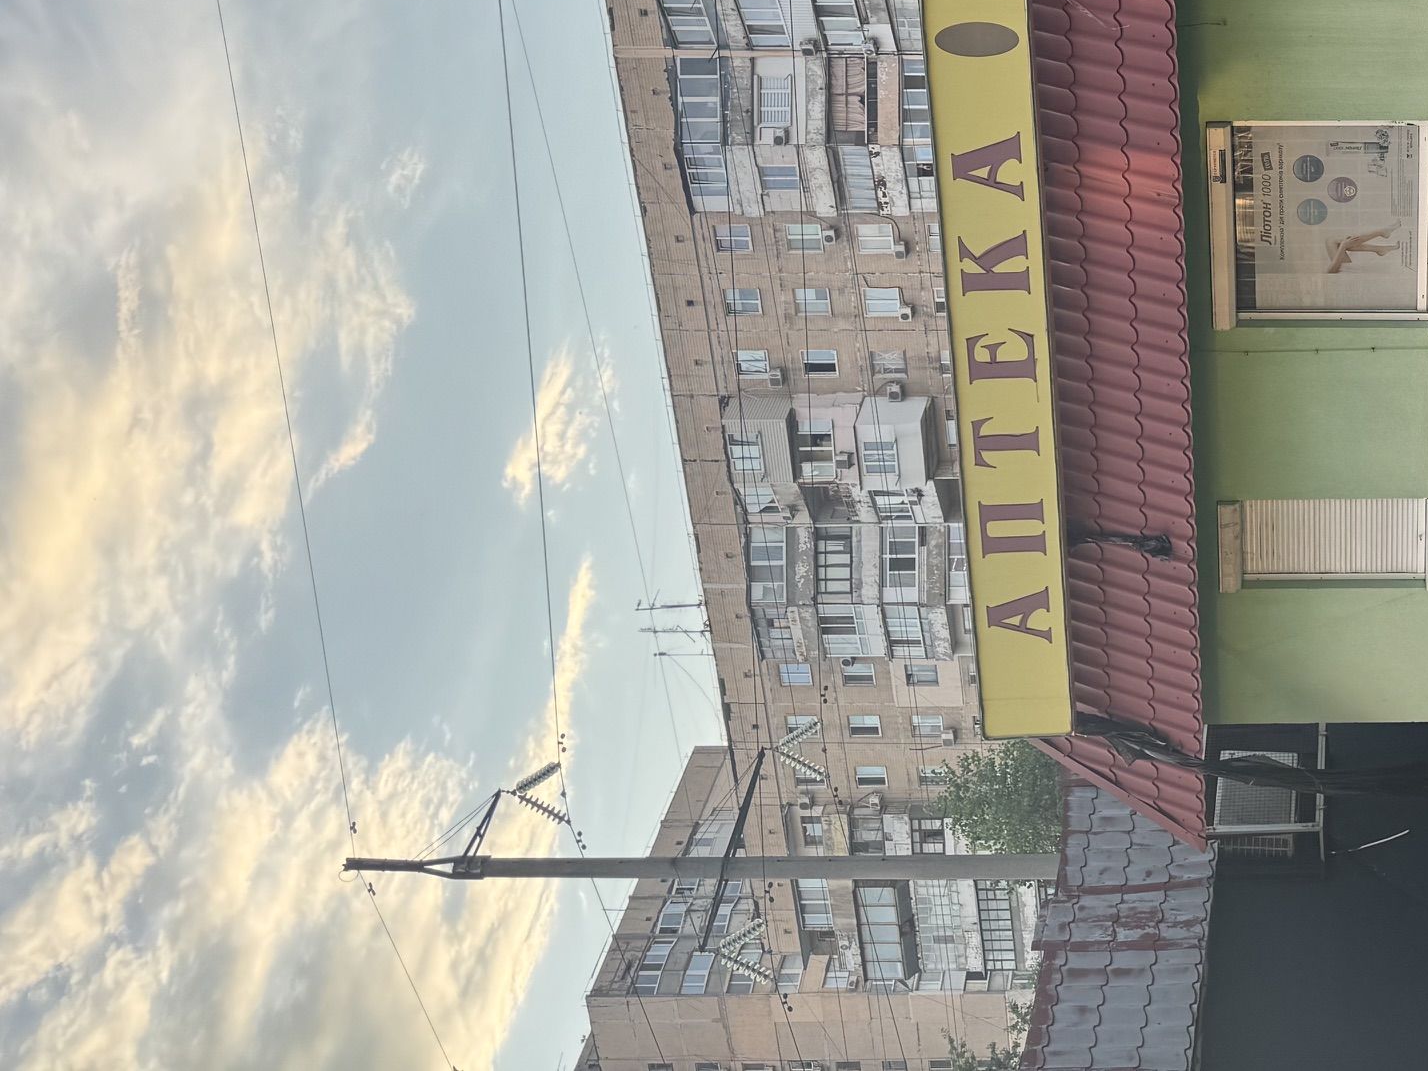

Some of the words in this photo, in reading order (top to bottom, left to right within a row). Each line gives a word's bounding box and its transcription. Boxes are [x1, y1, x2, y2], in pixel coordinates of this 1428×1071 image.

[1261, 174, 1272, 197] 1000
[1260, 202, 1272, 245] Ліотон
[949, 130, 1053, 645] АПТЕКА
